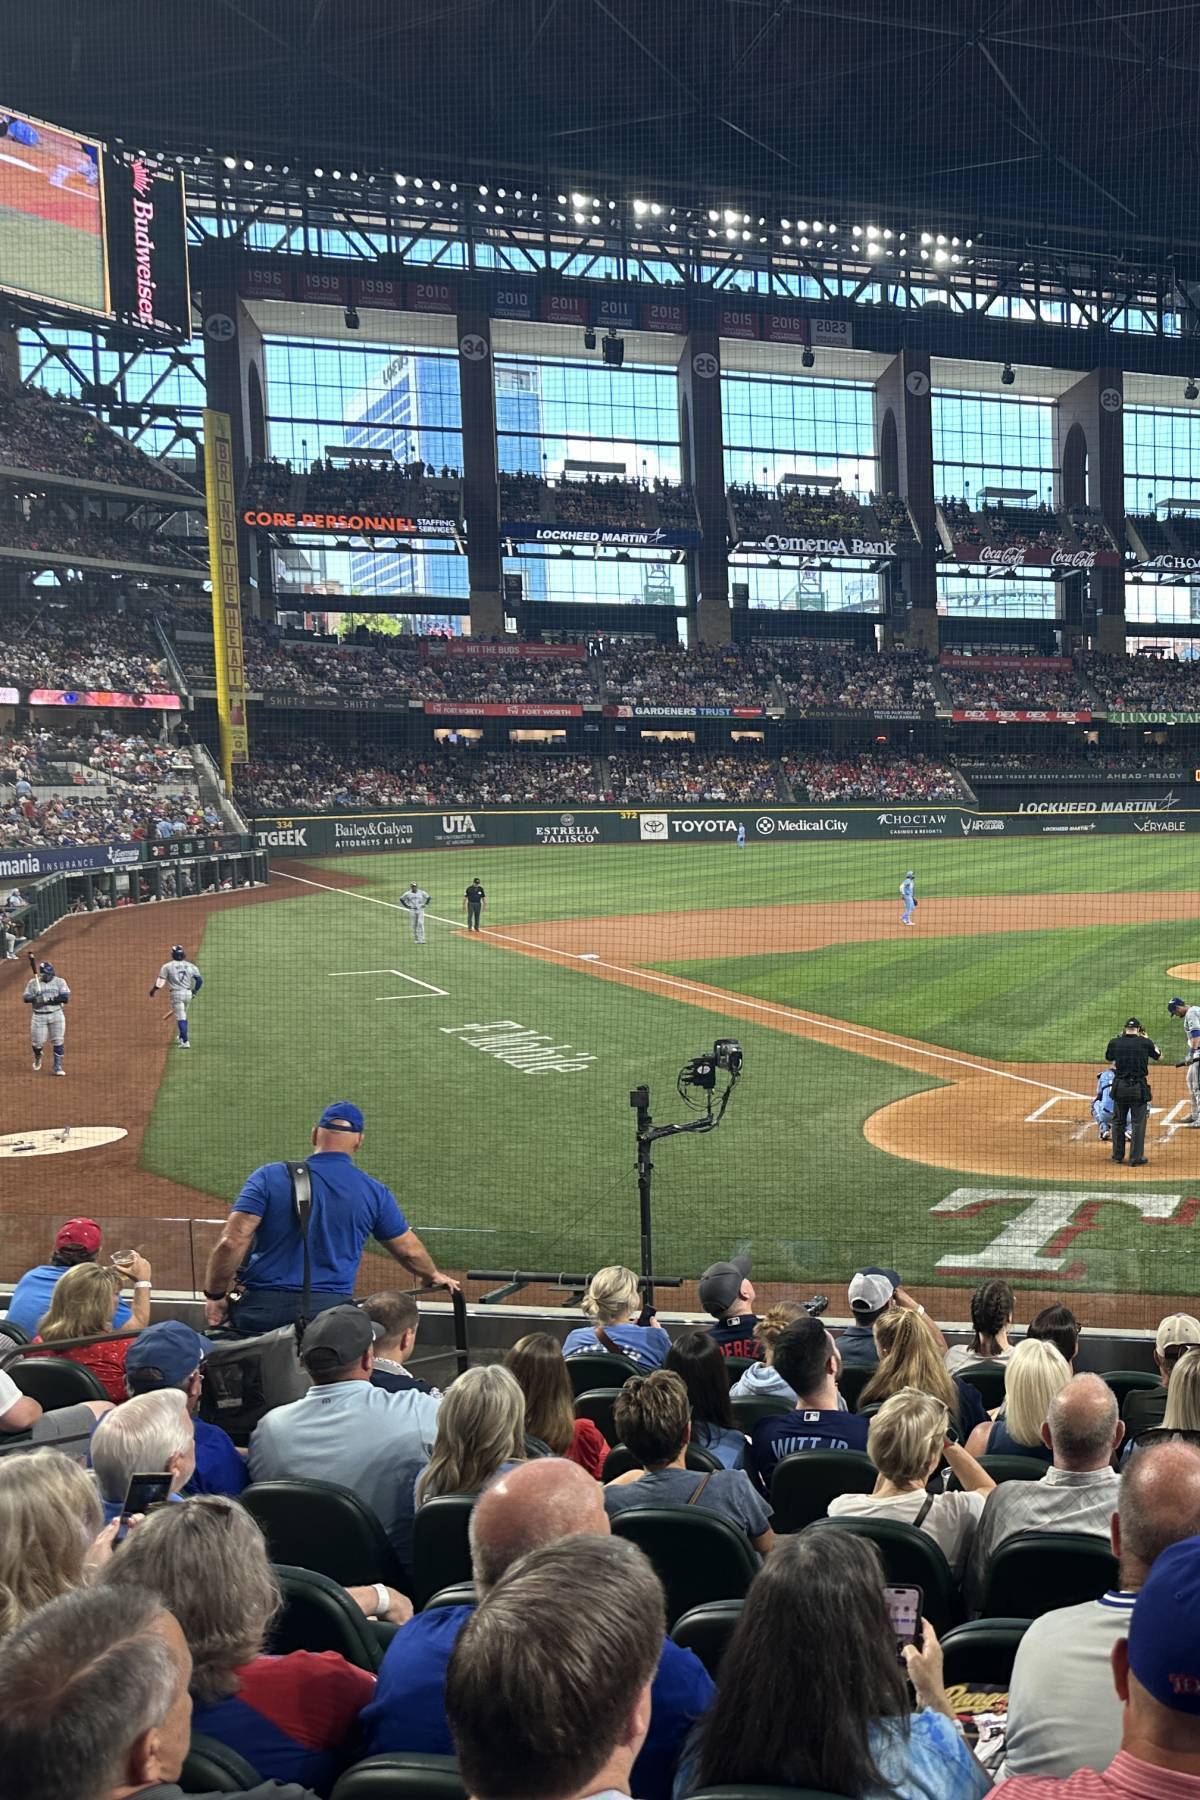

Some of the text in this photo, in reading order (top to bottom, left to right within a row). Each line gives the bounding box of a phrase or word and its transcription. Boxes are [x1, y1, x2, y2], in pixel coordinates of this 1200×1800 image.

[133, 198, 156, 324] Budweiser
[248, 270, 282, 285] 1996
[305, 275, 339, 289] 1998
[360, 279, 393, 294] 1999
[416, 284, 449, 298] 2010
[497, 292, 528, 305] 2010
[551, 297, 578, 310] 2011
[601, 301, 628, 314] 2011
[651, 305, 680, 320] 2012
[723, 312, 752, 325] 2015
[772, 316, 799, 330] 2016
[207, 319, 232, 336] 42
[816, 320, 847, 334] 2023
[463, 340, 485, 355] 34
[695, 358, 716, 373] 26
[912, 376, 922, 391] 7
[1103, 393, 1119, 407] 29
[219, 443, 231, 539] BRING
[244, 511, 417, 532] CORE PERSONNEL
[417, 518, 455, 527] STAFFING
[418, 525, 455, 534] SERVICES
[536, 530, 648, 543] LOCKHEED MARTIN
[851, 538, 897, 555] Bank
[229, 609, 238, 684] HEAT
[270, 697, 297, 705] SHIFT
[344, 700, 369, 708] SHIFT
[635, 707, 696, 716] GARDENERS
[699, 708, 731, 716] TRUST
[1121, 712, 1167, 723] LUXOR
[1018, 801, 1157, 813] LOCKHEED MARTIN
[276, 821, 292, 829] 334
[442, 815, 476, 833] UTA
[885, 814, 947, 824] CHOCTAW
[536, 827, 600, 835] ESTRELLA
[672, 820, 738, 833] TOYOTA
[255, 828, 307, 847] TGEEK
[335, 840, 380, 848] ATTORNEYS
[397, 837, 413, 845] LAW
[542, 834, 594, 843] JALISCO
[42, 858, 94, 871] INSURANCE
[771, 1436, 822, 1459] WITT
